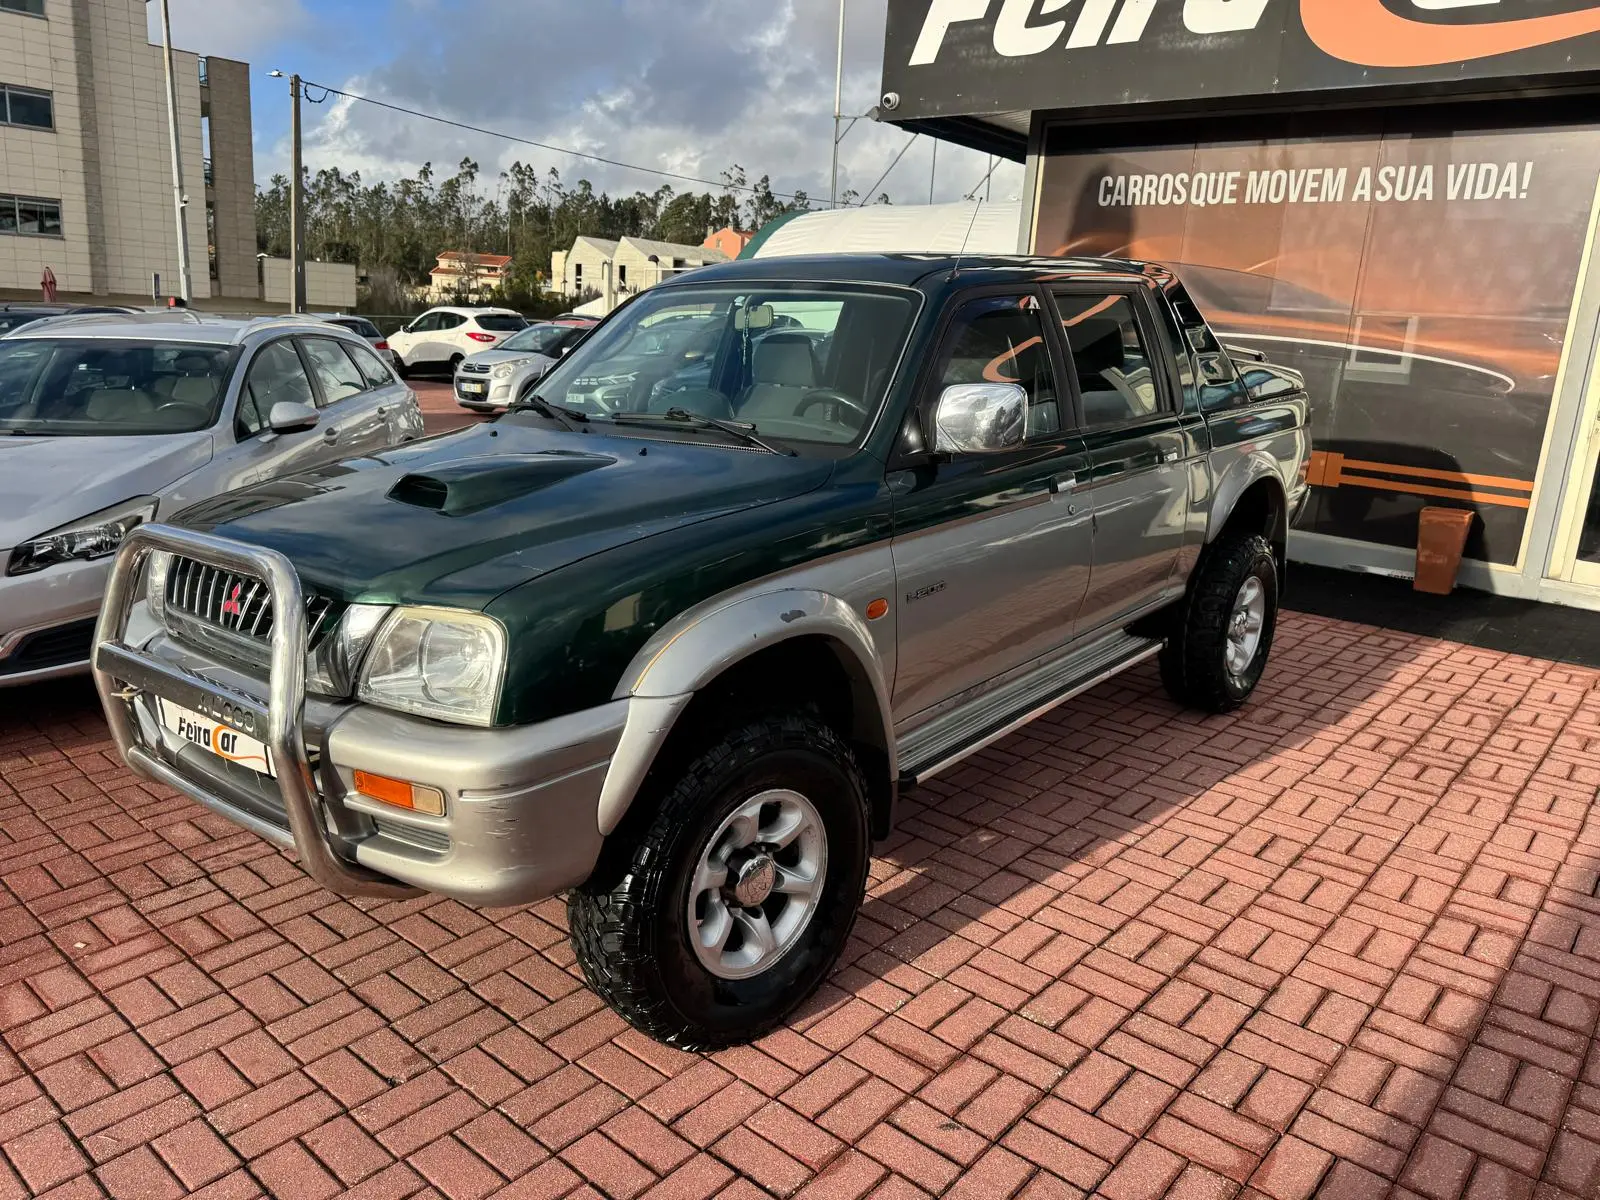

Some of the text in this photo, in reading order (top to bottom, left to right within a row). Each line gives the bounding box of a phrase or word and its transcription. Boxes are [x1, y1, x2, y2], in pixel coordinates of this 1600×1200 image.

[1098, 161, 1534, 207] CARROS QUE MOVEM A SUA VIDA!
